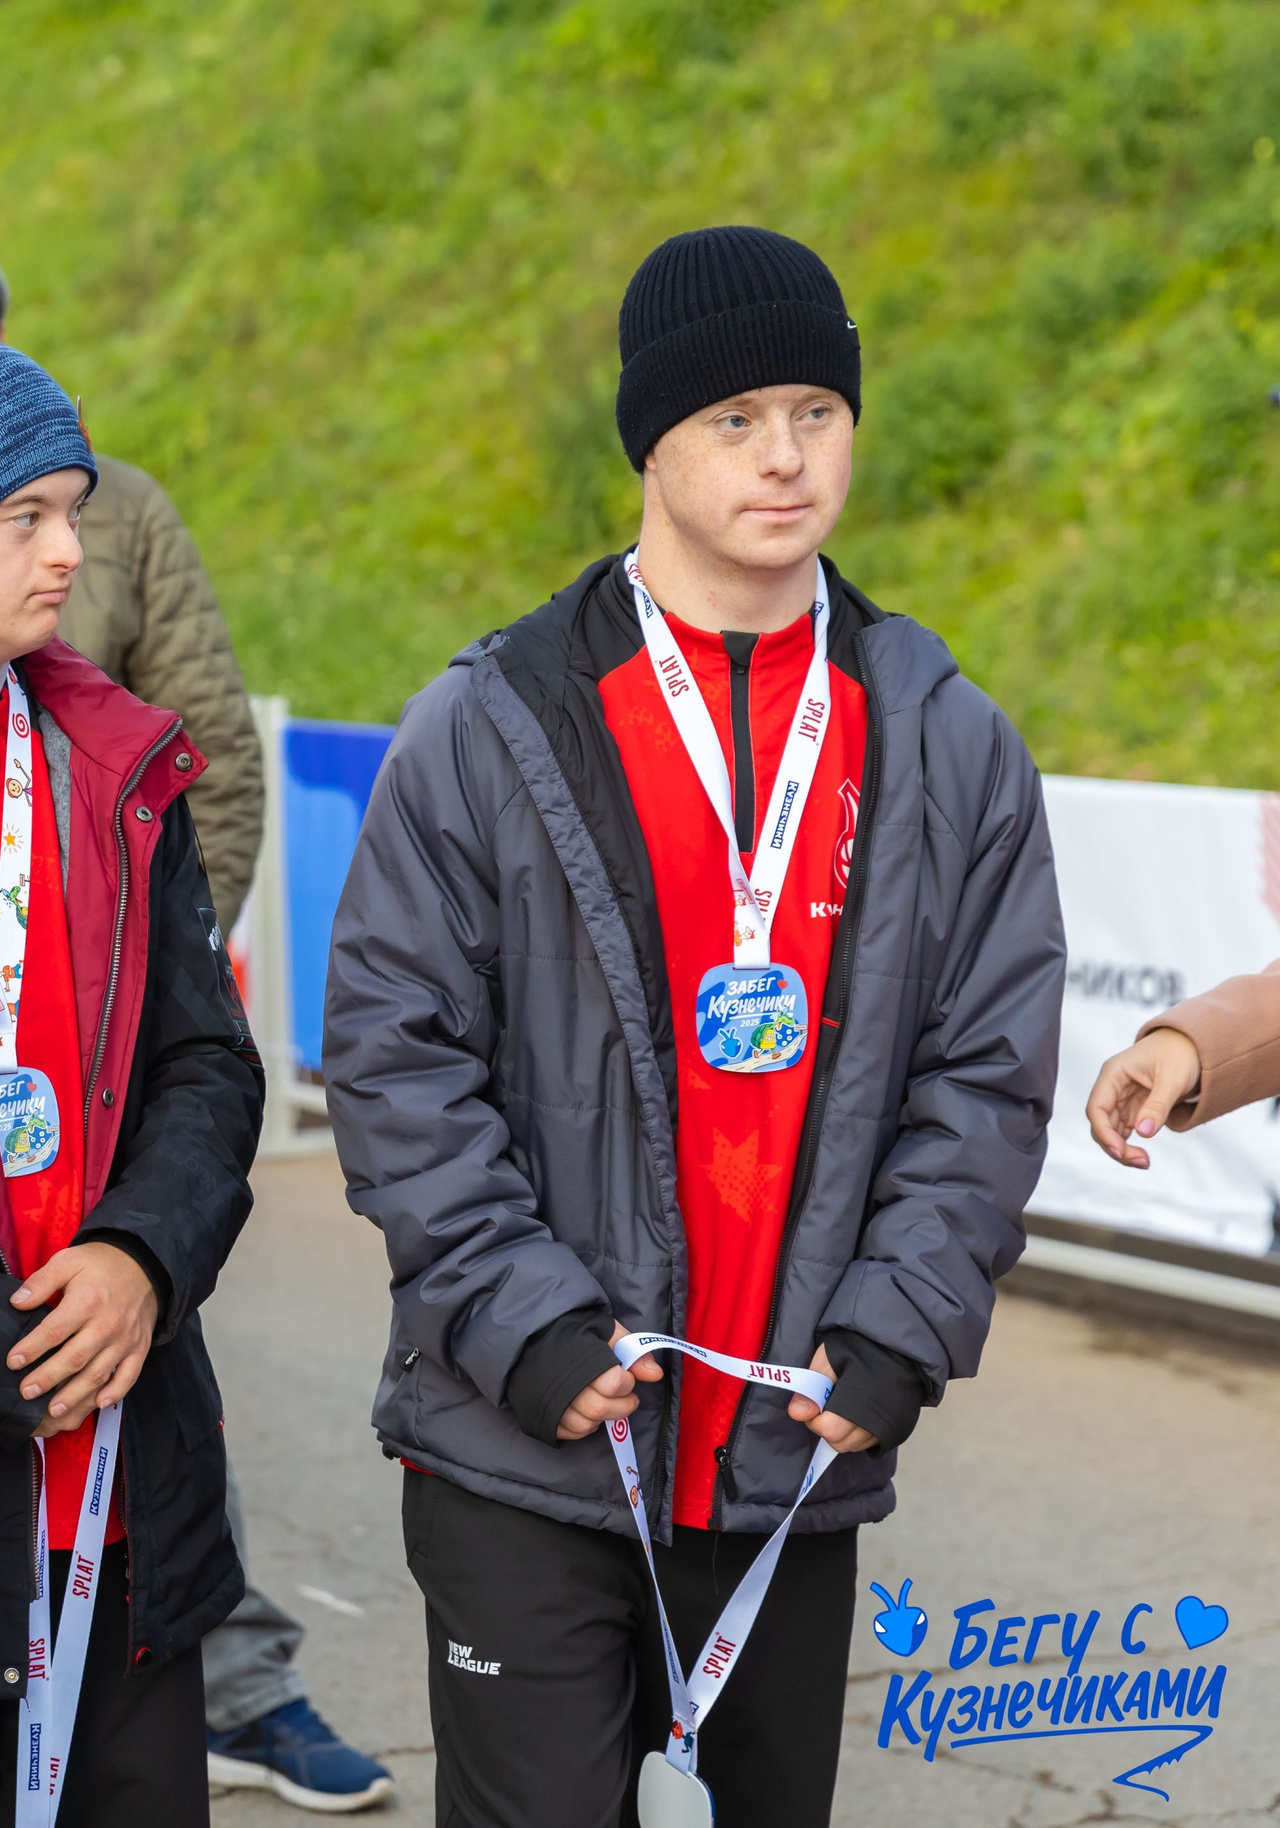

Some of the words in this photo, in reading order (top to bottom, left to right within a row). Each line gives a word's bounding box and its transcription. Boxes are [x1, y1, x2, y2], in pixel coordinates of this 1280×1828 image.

[658, 654, 689, 698] SPLAT
[798, 698, 825, 742] SPLAT
[771, 781, 799, 849] КУЗНЕЧИКИ
[726, 977, 776, 996] ЗАБЕГ
[740, 1019, 760, 1028] 2025
[749, 1364, 791, 1384] SPLAT
[90, 1447, 108, 1516] КУЗНЕЧИКИ
[72, 1554, 95, 1599] SPLAT
[28, 1638, 46, 1679] SPLAT
[447, 1652, 501, 1676] LEAGUE
[702, 1635, 737, 1679] SPLAT
[29, 1723, 41, 1790] КУЗНЕЧИКИ
